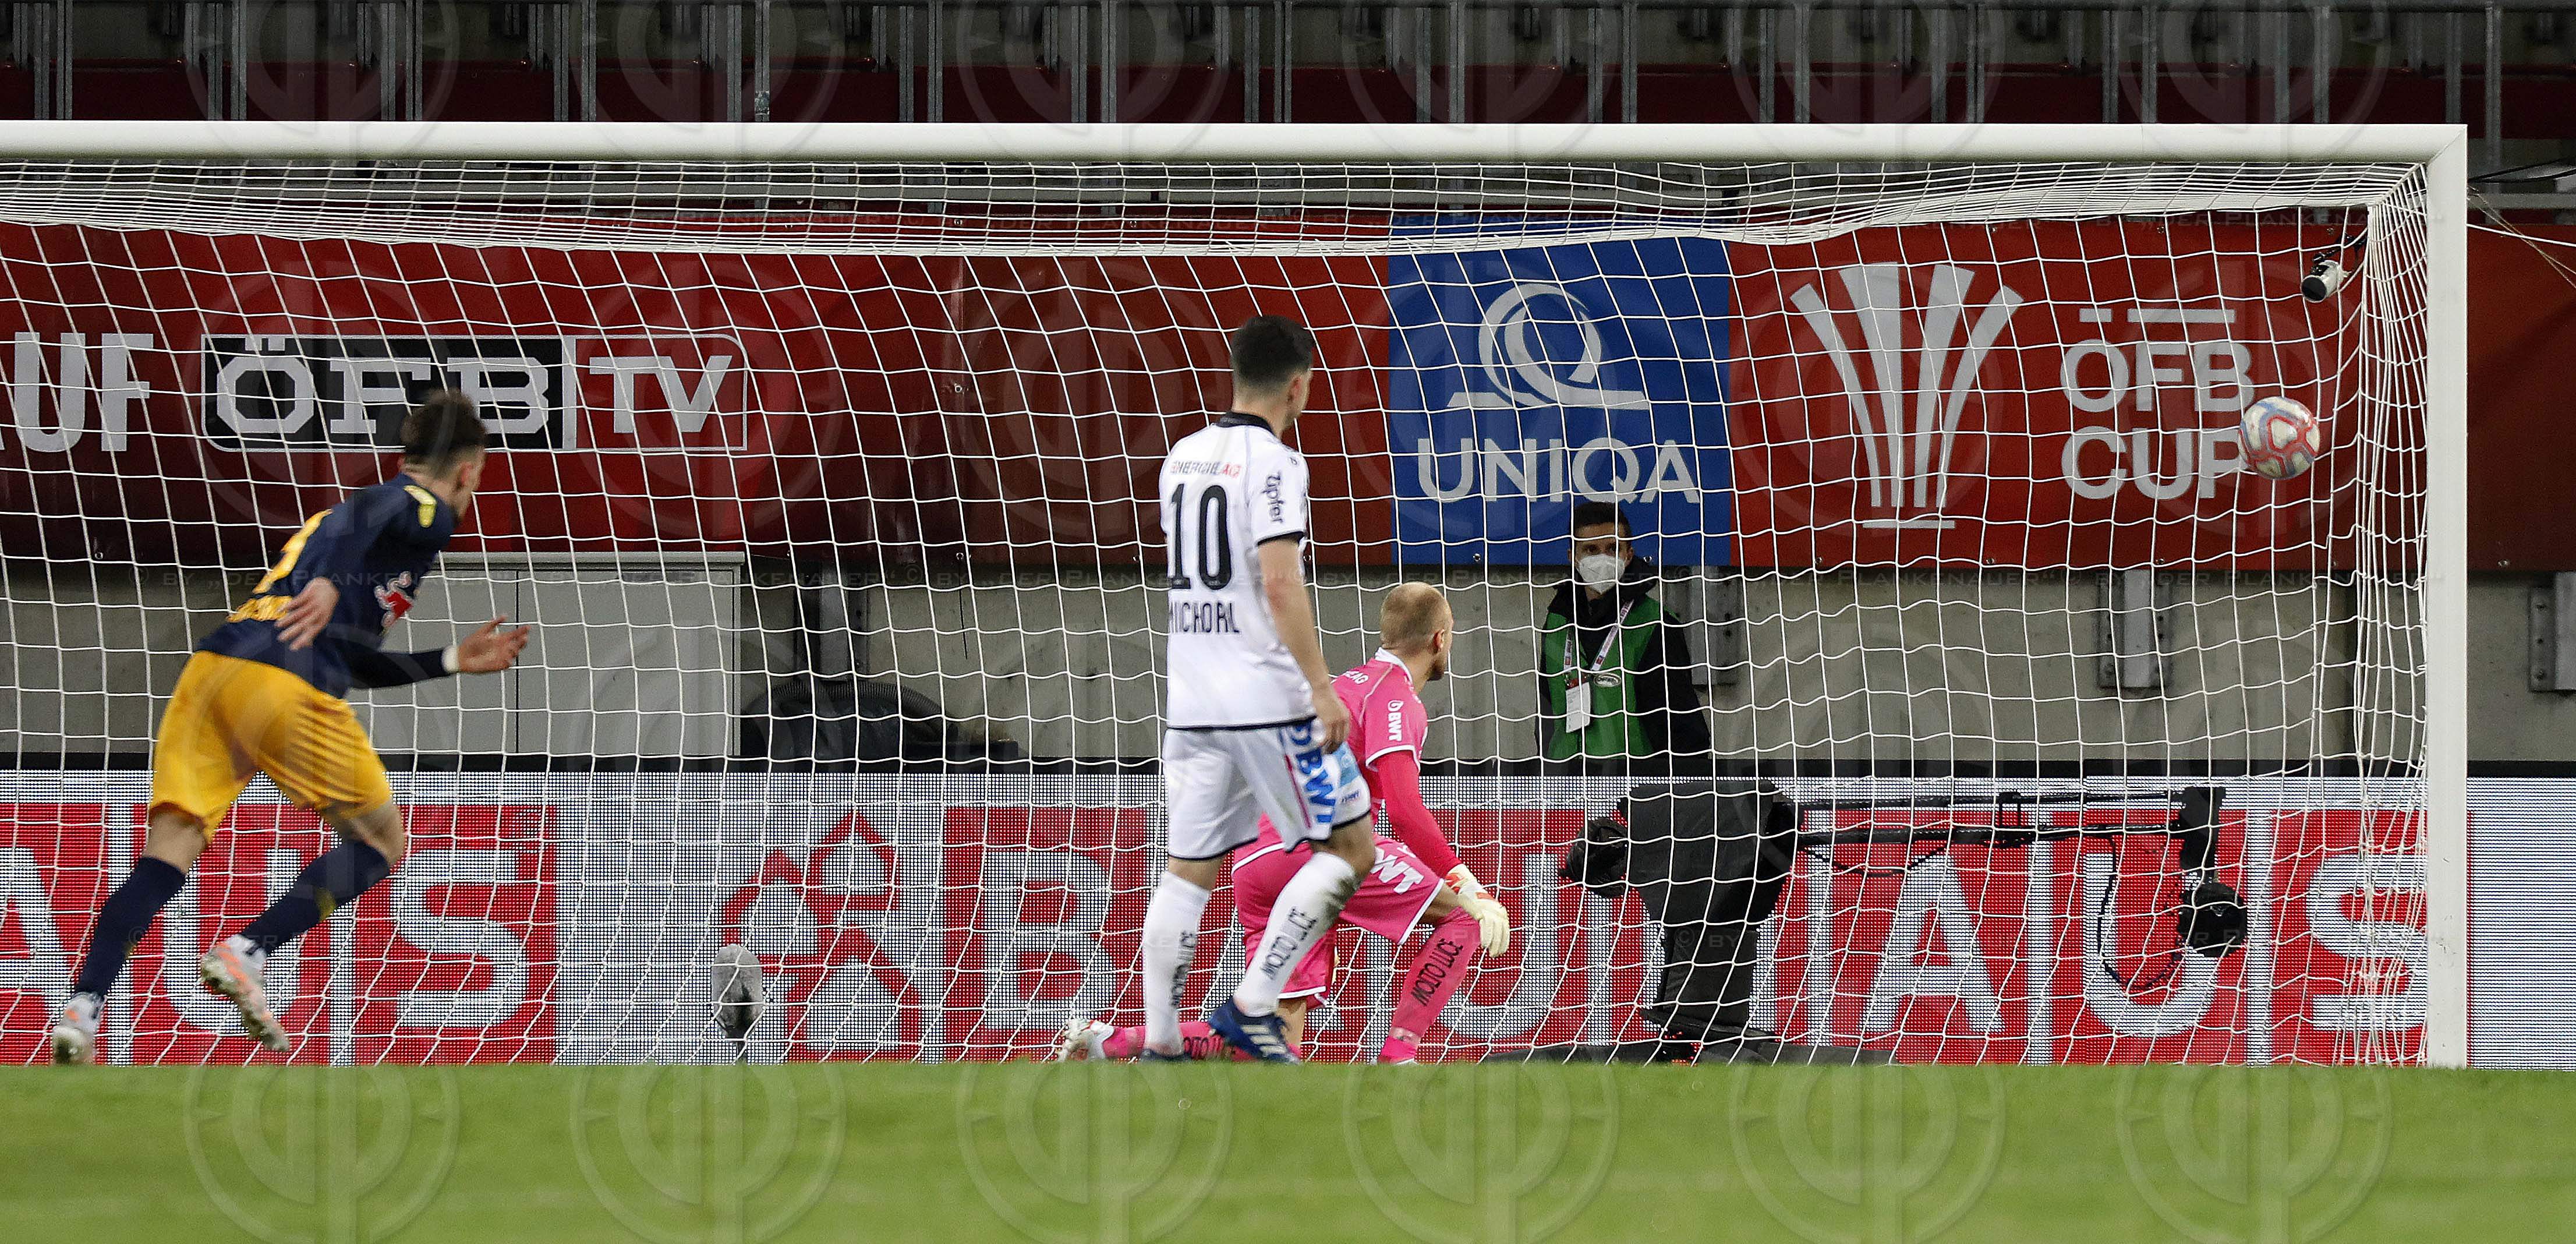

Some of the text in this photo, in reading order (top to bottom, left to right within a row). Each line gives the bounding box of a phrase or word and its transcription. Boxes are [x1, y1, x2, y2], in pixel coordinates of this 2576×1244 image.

[0, 332, 154, 452] UF
[217, 334, 733, 434] ÖFB TV
[1417, 438, 1700, 504] UNIQA
[2061, 426, 2248, 500] CUP
[1170, 483, 1232, 590] 10
[1388, 713, 1402, 742] BWT
[1370, 846, 1424, 895] WT
